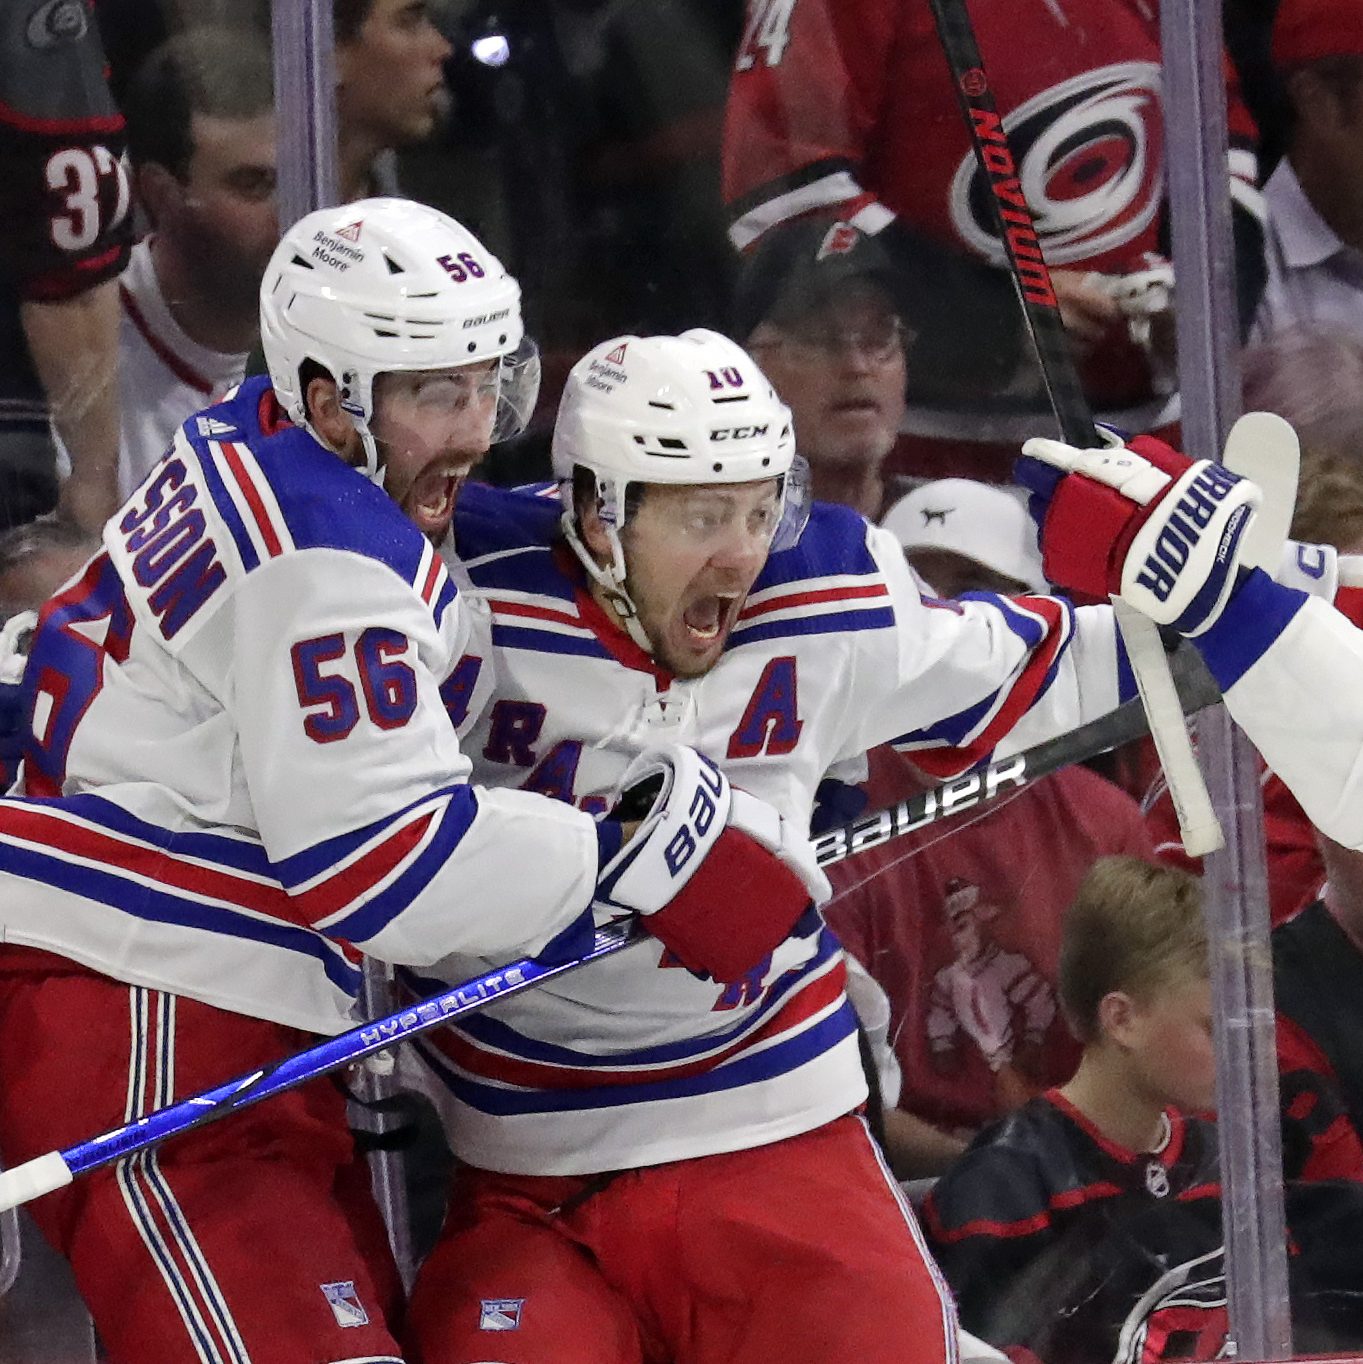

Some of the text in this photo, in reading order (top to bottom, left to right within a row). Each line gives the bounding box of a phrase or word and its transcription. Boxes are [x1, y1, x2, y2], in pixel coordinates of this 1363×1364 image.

[967, 107, 1058, 307] NOVIUM
[311, 246, 351, 272] Moore
[313, 231, 365, 263] Benjamin
[436, 252, 486, 283] 56
[701, 366, 744, 391] 10
[709, 424, 769, 441] CCM
[290, 626, 418, 744] 56
[726, 655, 804, 760] A
[663, 752, 725, 878] BAU
[815, 754, 1027, 867] BAUER
[360, 967, 525, 1046] HYPERLITE
